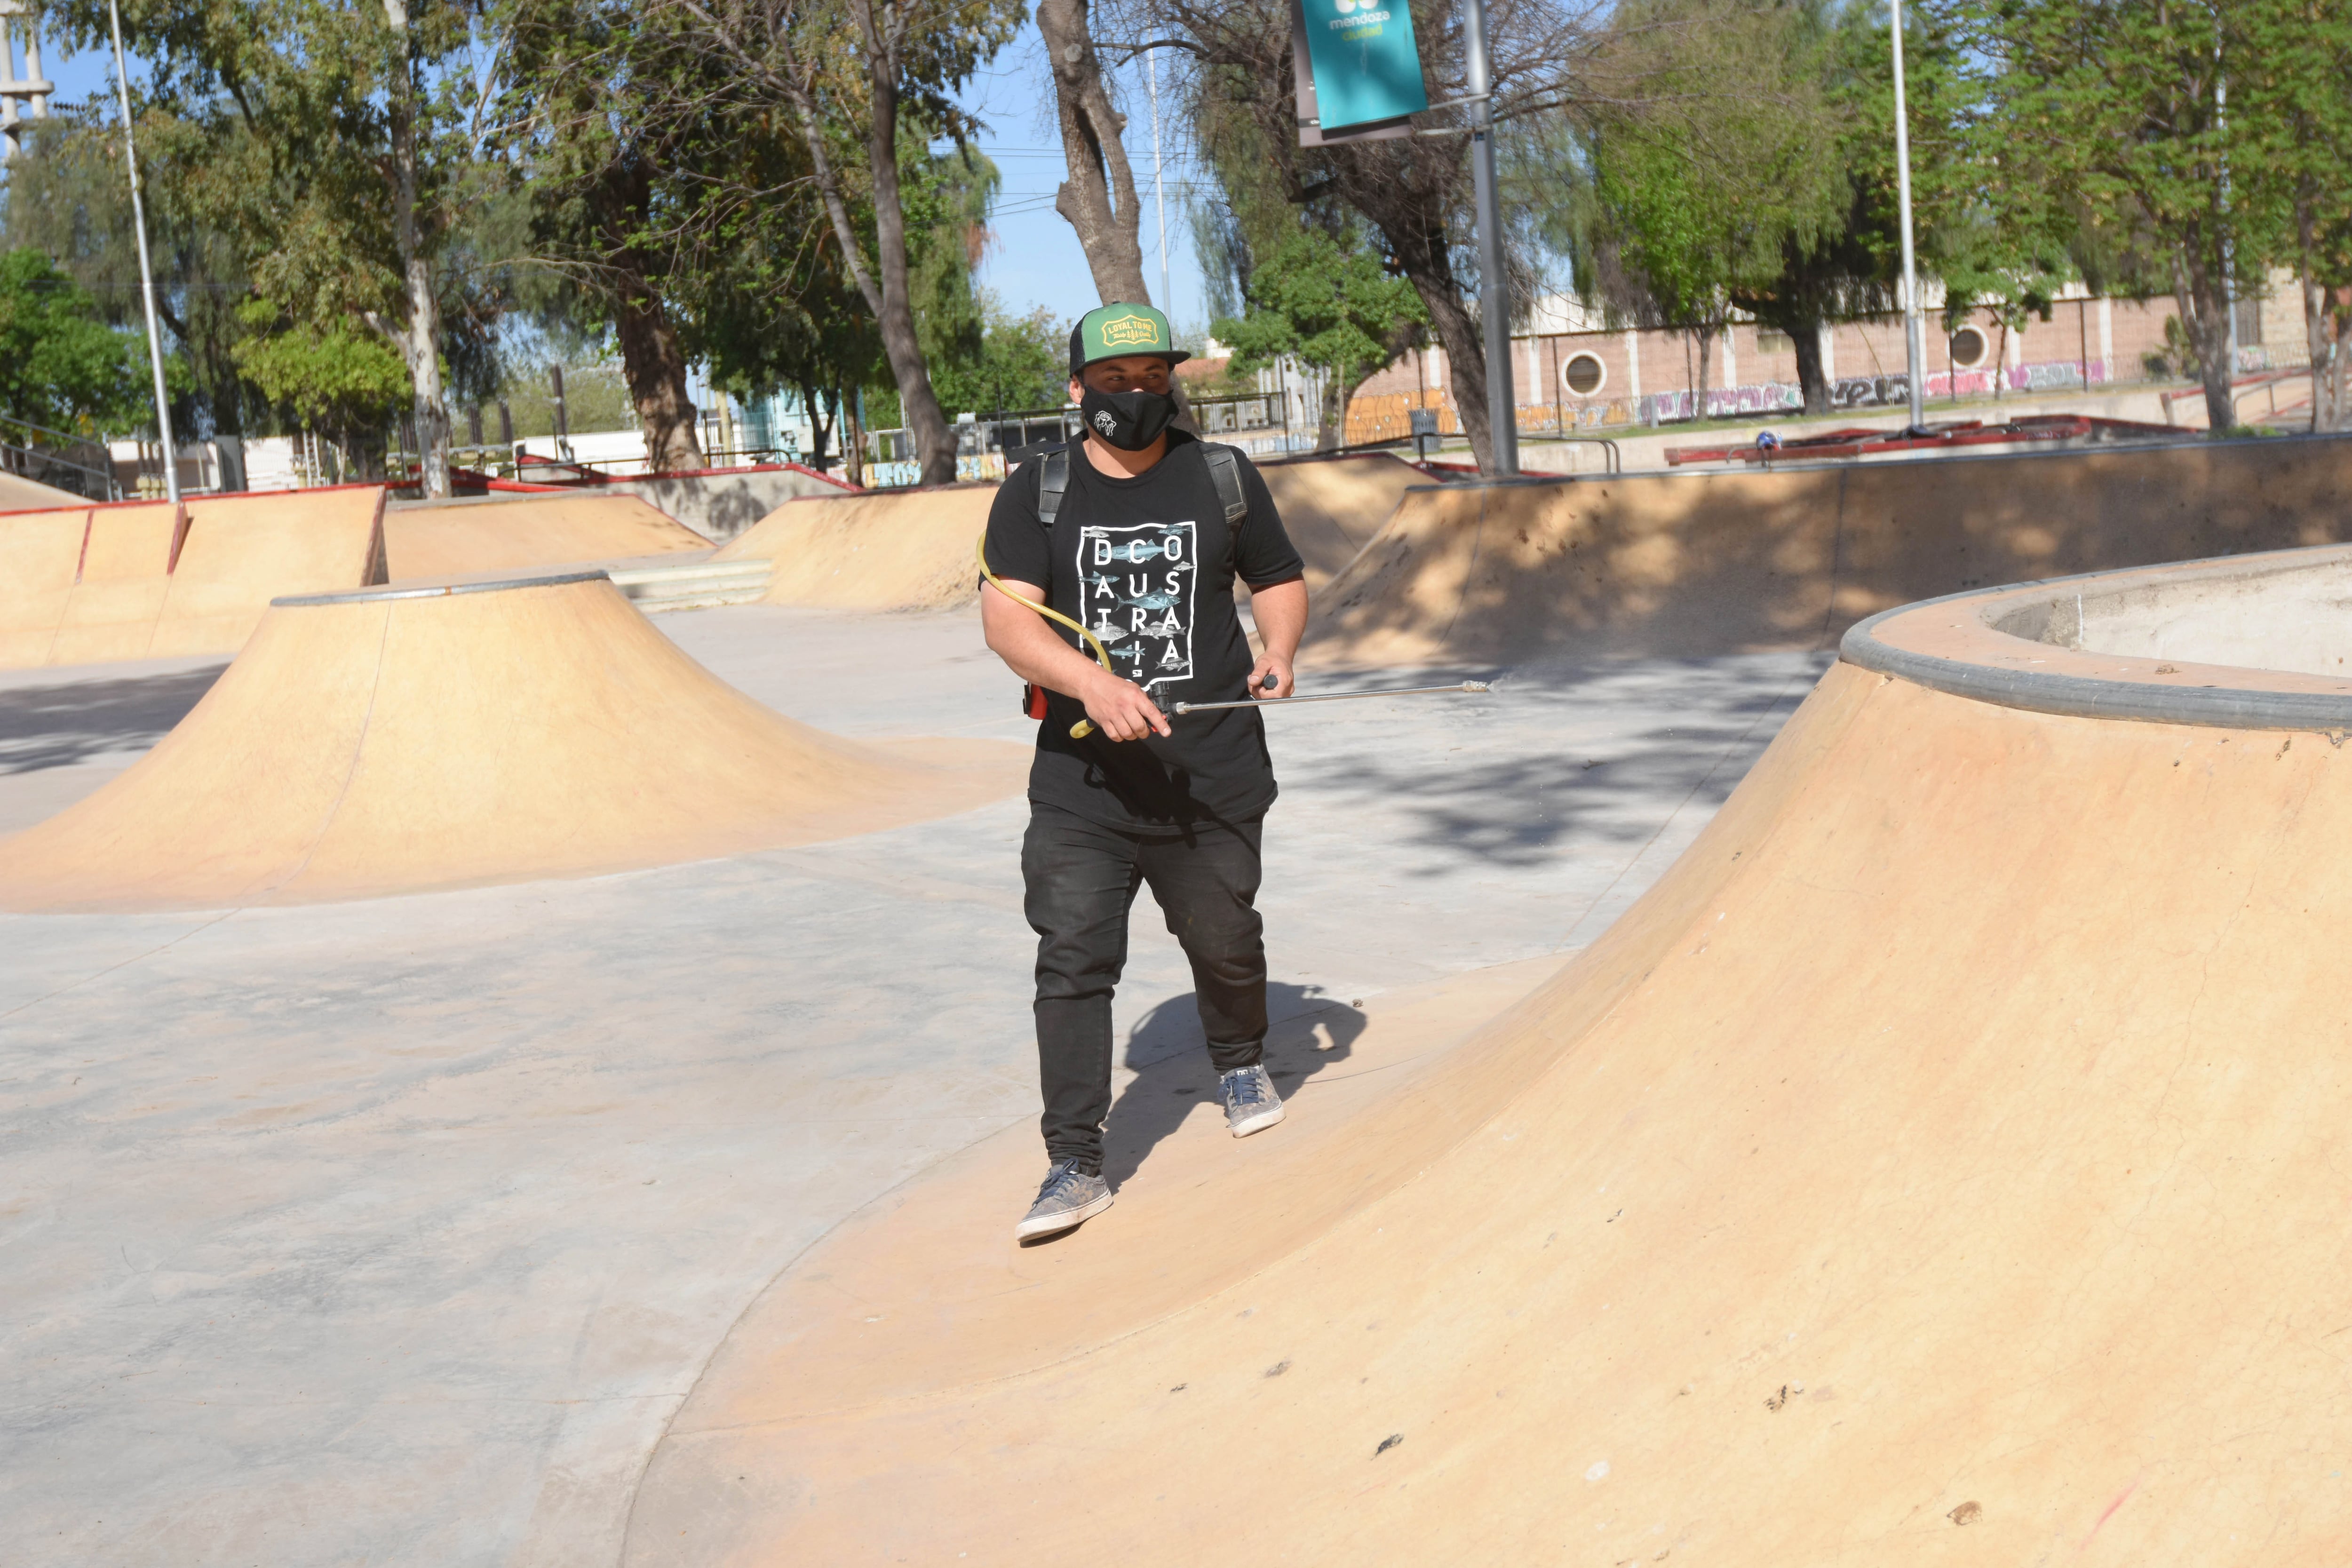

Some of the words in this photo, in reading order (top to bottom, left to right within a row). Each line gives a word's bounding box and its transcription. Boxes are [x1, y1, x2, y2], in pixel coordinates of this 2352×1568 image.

[1329, 11, 1391, 30] mendoza
[1343, 23, 1383, 41] ciudad
[1108, 322, 1132, 334] LOYAL
[1143, 323, 1152, 332] ME
